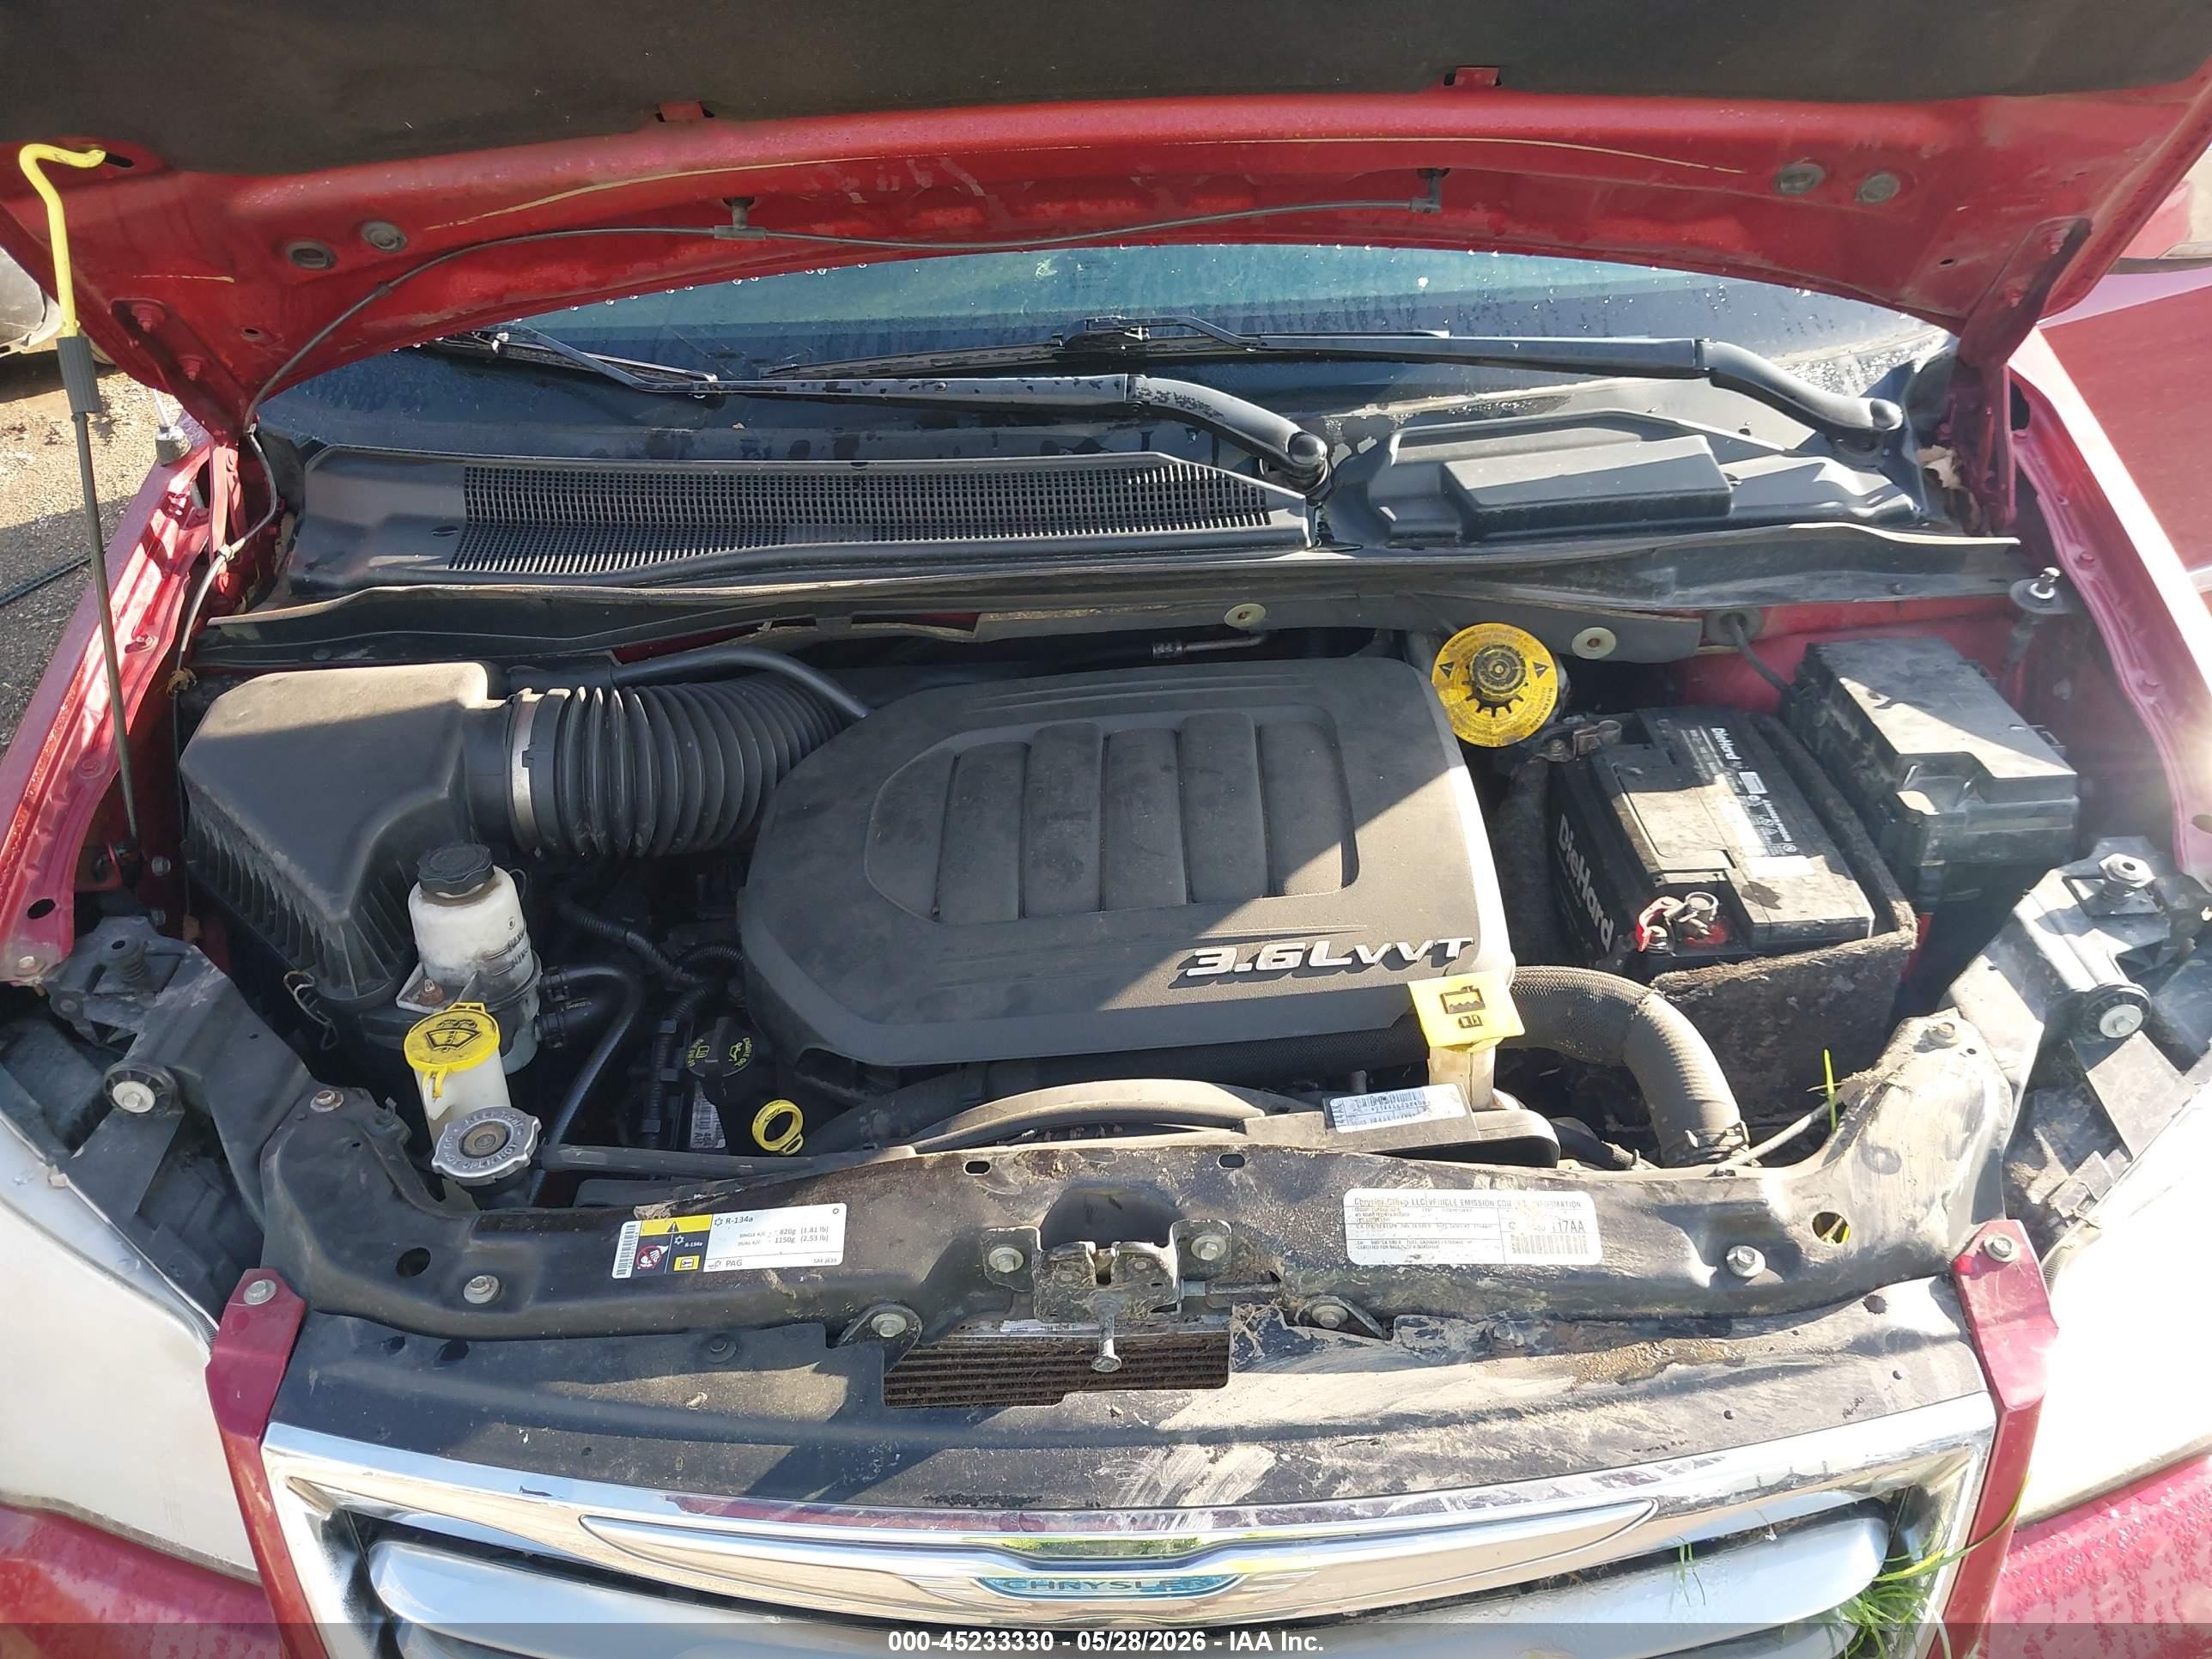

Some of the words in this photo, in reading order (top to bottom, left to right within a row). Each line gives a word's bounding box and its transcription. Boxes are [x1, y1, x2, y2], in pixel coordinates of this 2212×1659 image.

[1711, 727, 1741, 761] DieHard
[1558, 813, 1614, 953] DieHard
[1428, 1198, 1458, 1206] VEHICLE
[1460, 1199, 1495, 1207] EMISSION
[725, 1214, 756, 1225] R-134a
[779, 1228, 797, 1237] 820g
[800, 1226, 817, 1235] (1.81
[818, 1225, 829, 1235] lb)
[775, 1236, 796, 1244] 1150g
[800, 1234, 817, 1243] (2.53
[818, 1233, 829, 1243] lb)
[725, 1258, 743, 1268] PAG
[1002, 1577, 1209, 1591] CHRYSLER
